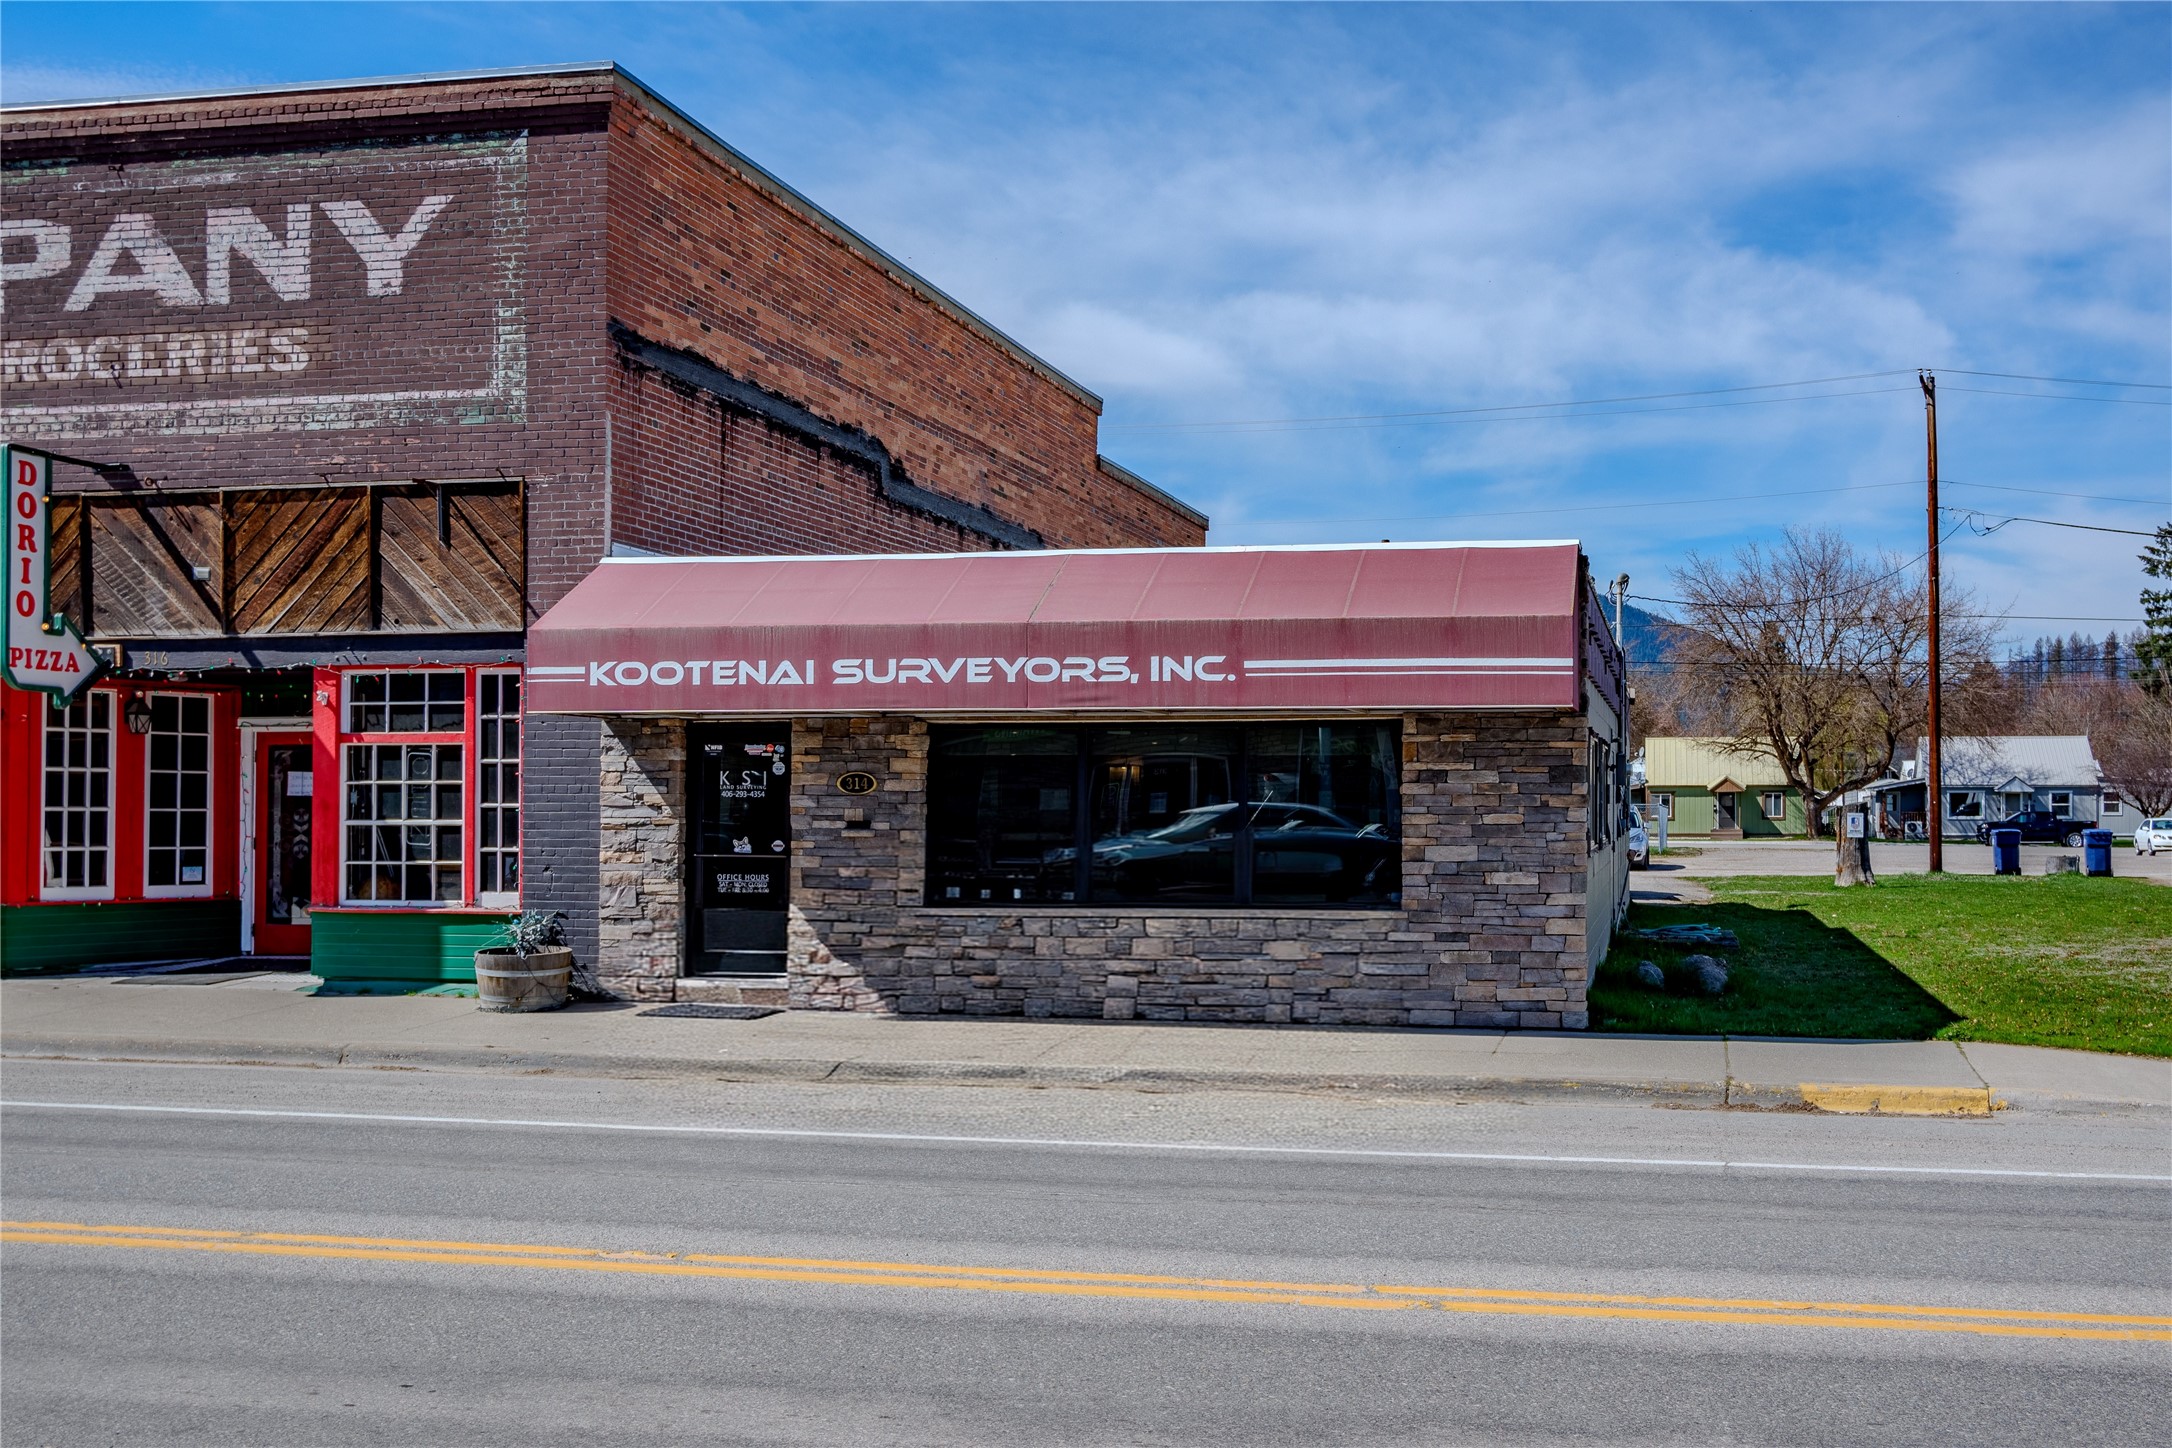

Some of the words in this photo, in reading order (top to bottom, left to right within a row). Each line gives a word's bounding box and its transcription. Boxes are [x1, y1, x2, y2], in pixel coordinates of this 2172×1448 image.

[16, 460, 38, 618] DORIO
[8, 647, 81, 673] PIZZA
[144, 651, 168, 666] 316
[589, 659, 814, 686] KOOTENAI
[832, 656, 1140, 684] SURVEYORS,
[1150, 655, 1236, 682] INC.
[846, 777, 869, 790] 314
[717, 873, 742, 881] OFFICE
